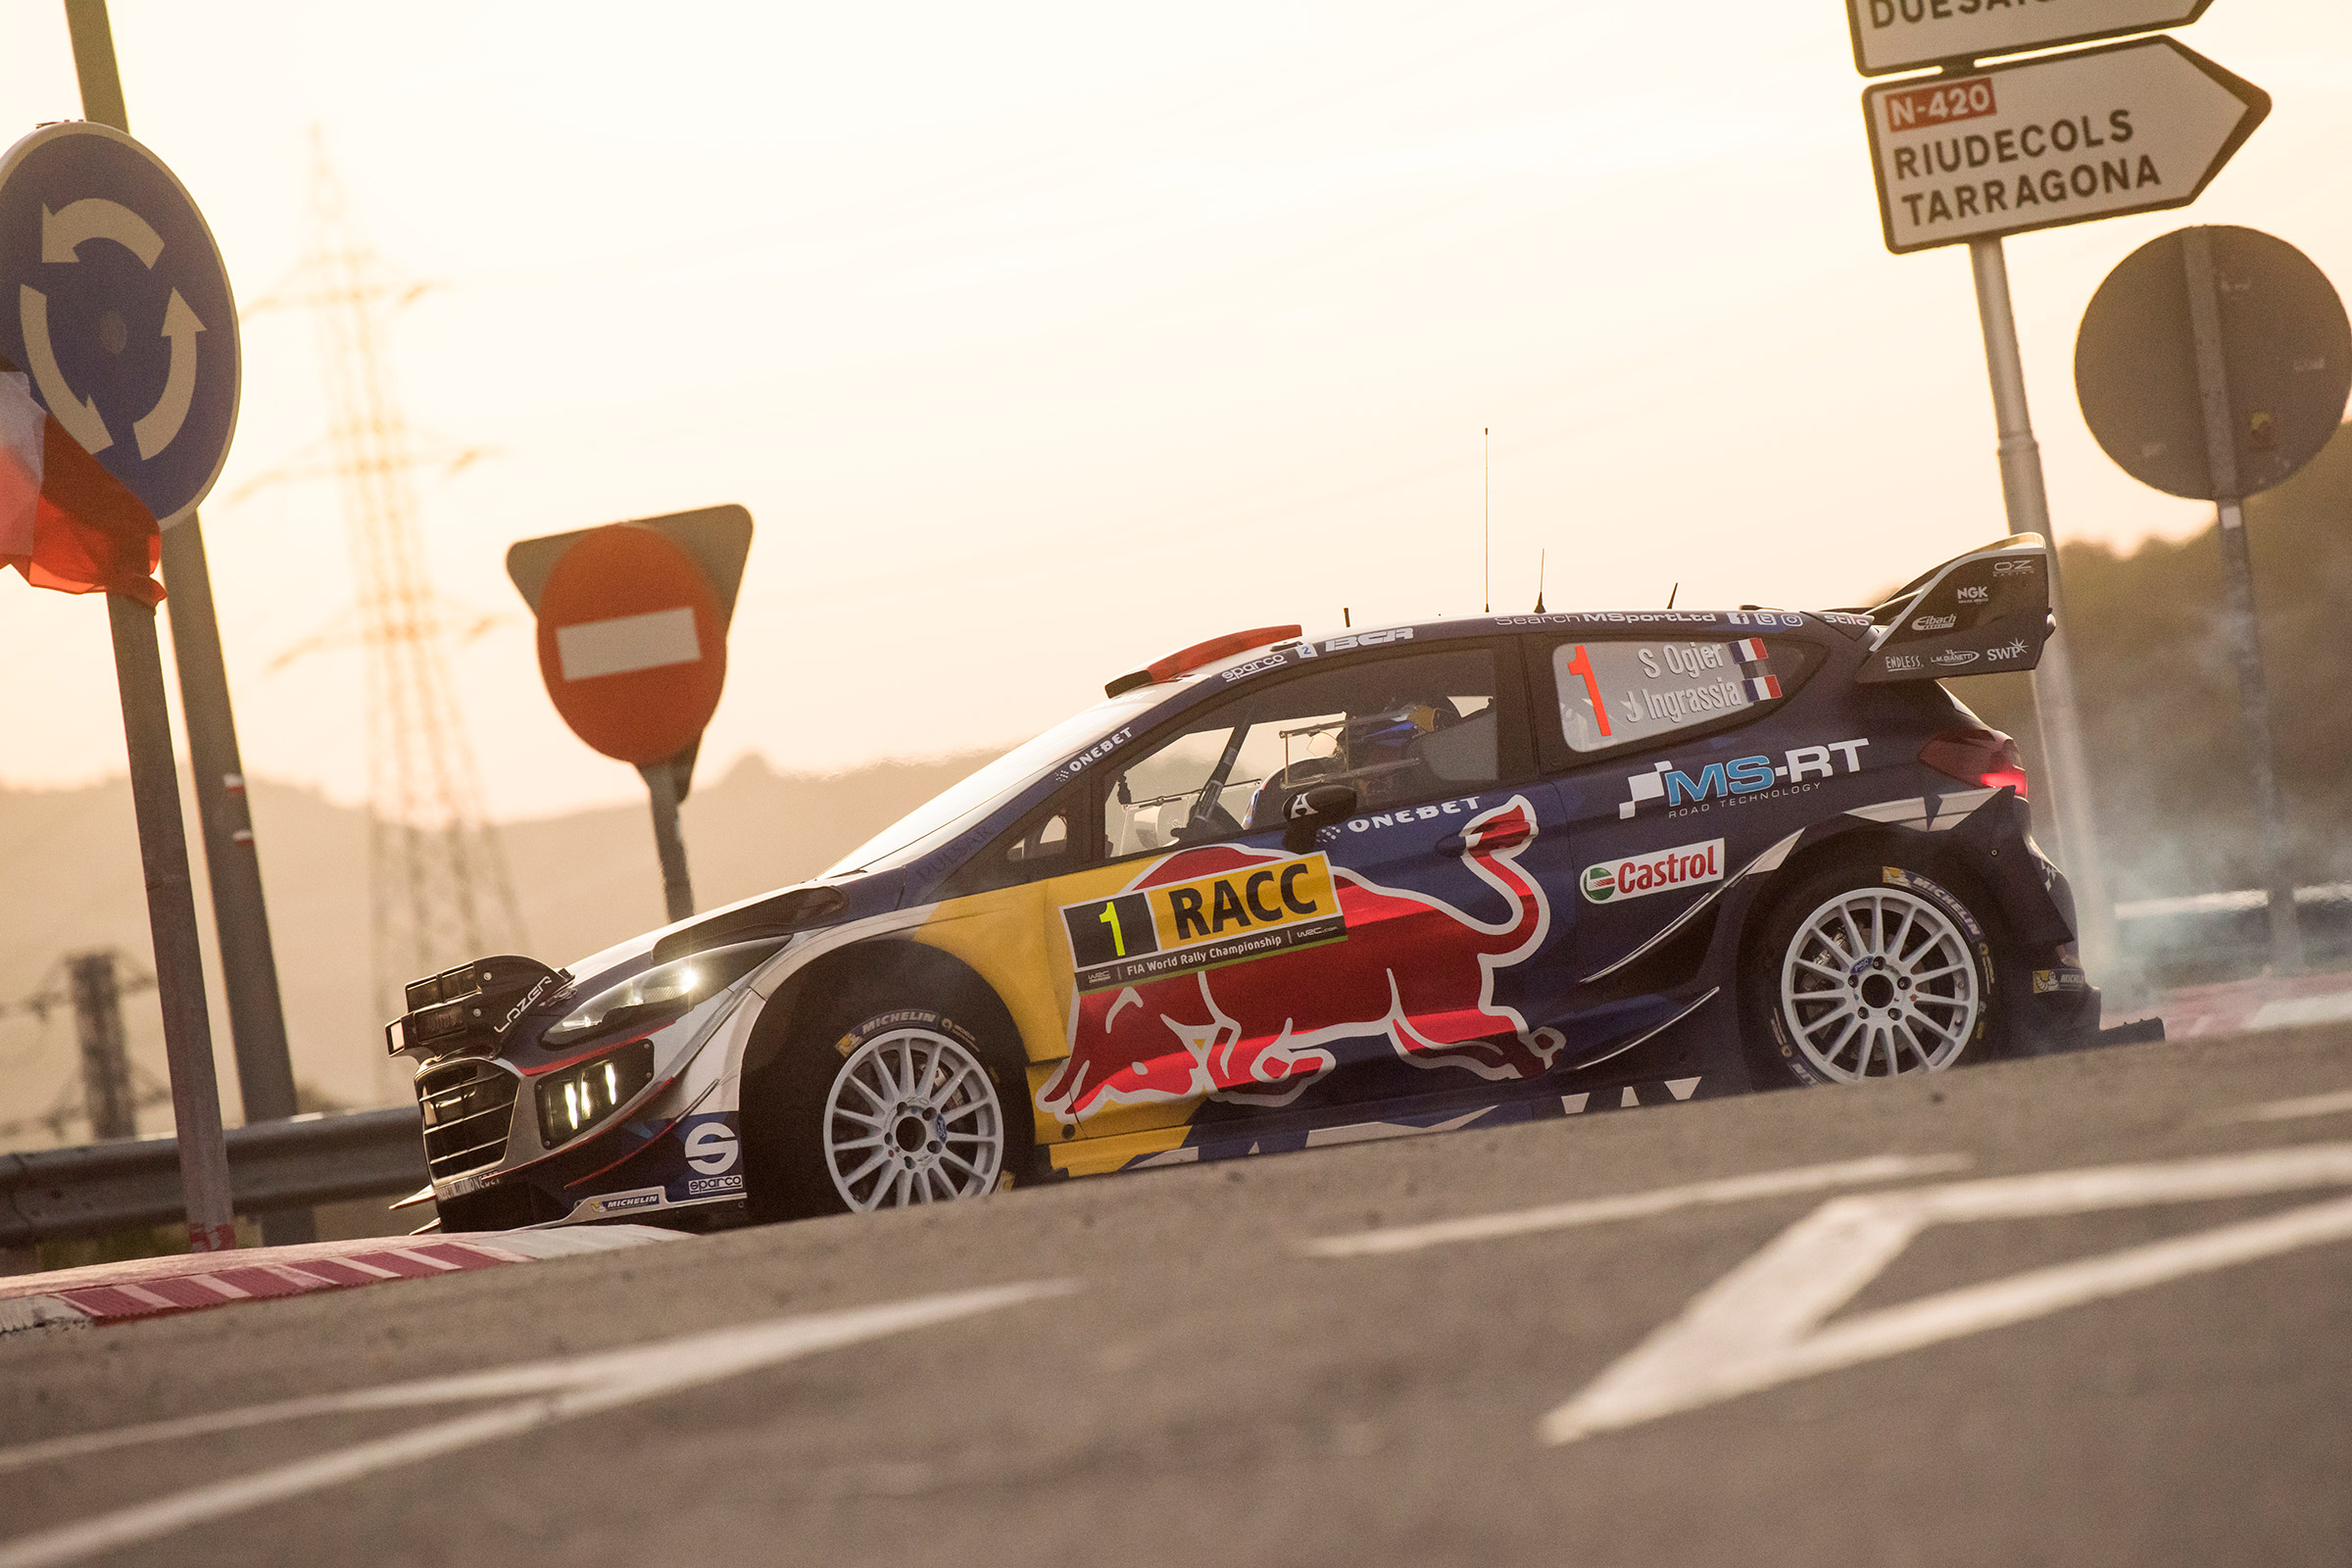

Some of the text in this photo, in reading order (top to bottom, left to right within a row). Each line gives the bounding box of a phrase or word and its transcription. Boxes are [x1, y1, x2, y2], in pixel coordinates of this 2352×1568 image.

[1890, 84, 1990, 126] N-420
[1893, 110, 2133, 180] RIUDECOLS
[1902, 155, 2162, 226] TARRAGONA
[1957, 586, 1987, 599] NGK
[1825, 614, 1870, 626] Stilo
[1911, 613, 1957, 631] Eibach
[1221, 654, 1286, 680] sparco
[1638, 642, 1725, 678] S Ogier
[1885, 655, 1921, 669] ENDLESS
[1986, 646, 2021, 662] SWP
[1568, 645, 1612, 737] 1
[1626, 676, 1741, 723] J Ingrassia
[1069, 726, 1132, 771] ONEBET
[1664, 738, 1869, 808] MS-RT
[1348, 796, 1481, 833] ONEBET
[1668, 781, 1822, 819] ROAD TECHNOLOGY
[1618, 845, 1718, 894] Castrol
[1168, 862, 1317, 941] RACC
[1913, 877, 1981, 935] MICHELIN
[1099, 902, 1126, 957] 1
[1127, 935, 1282, 976] FIA World Rally Championship
[862, 1011, 937, 1034] MICHELIN
[608, 1196, 659, 1208] MICHELIN
[690, 1176, 742, 1193] sparco
